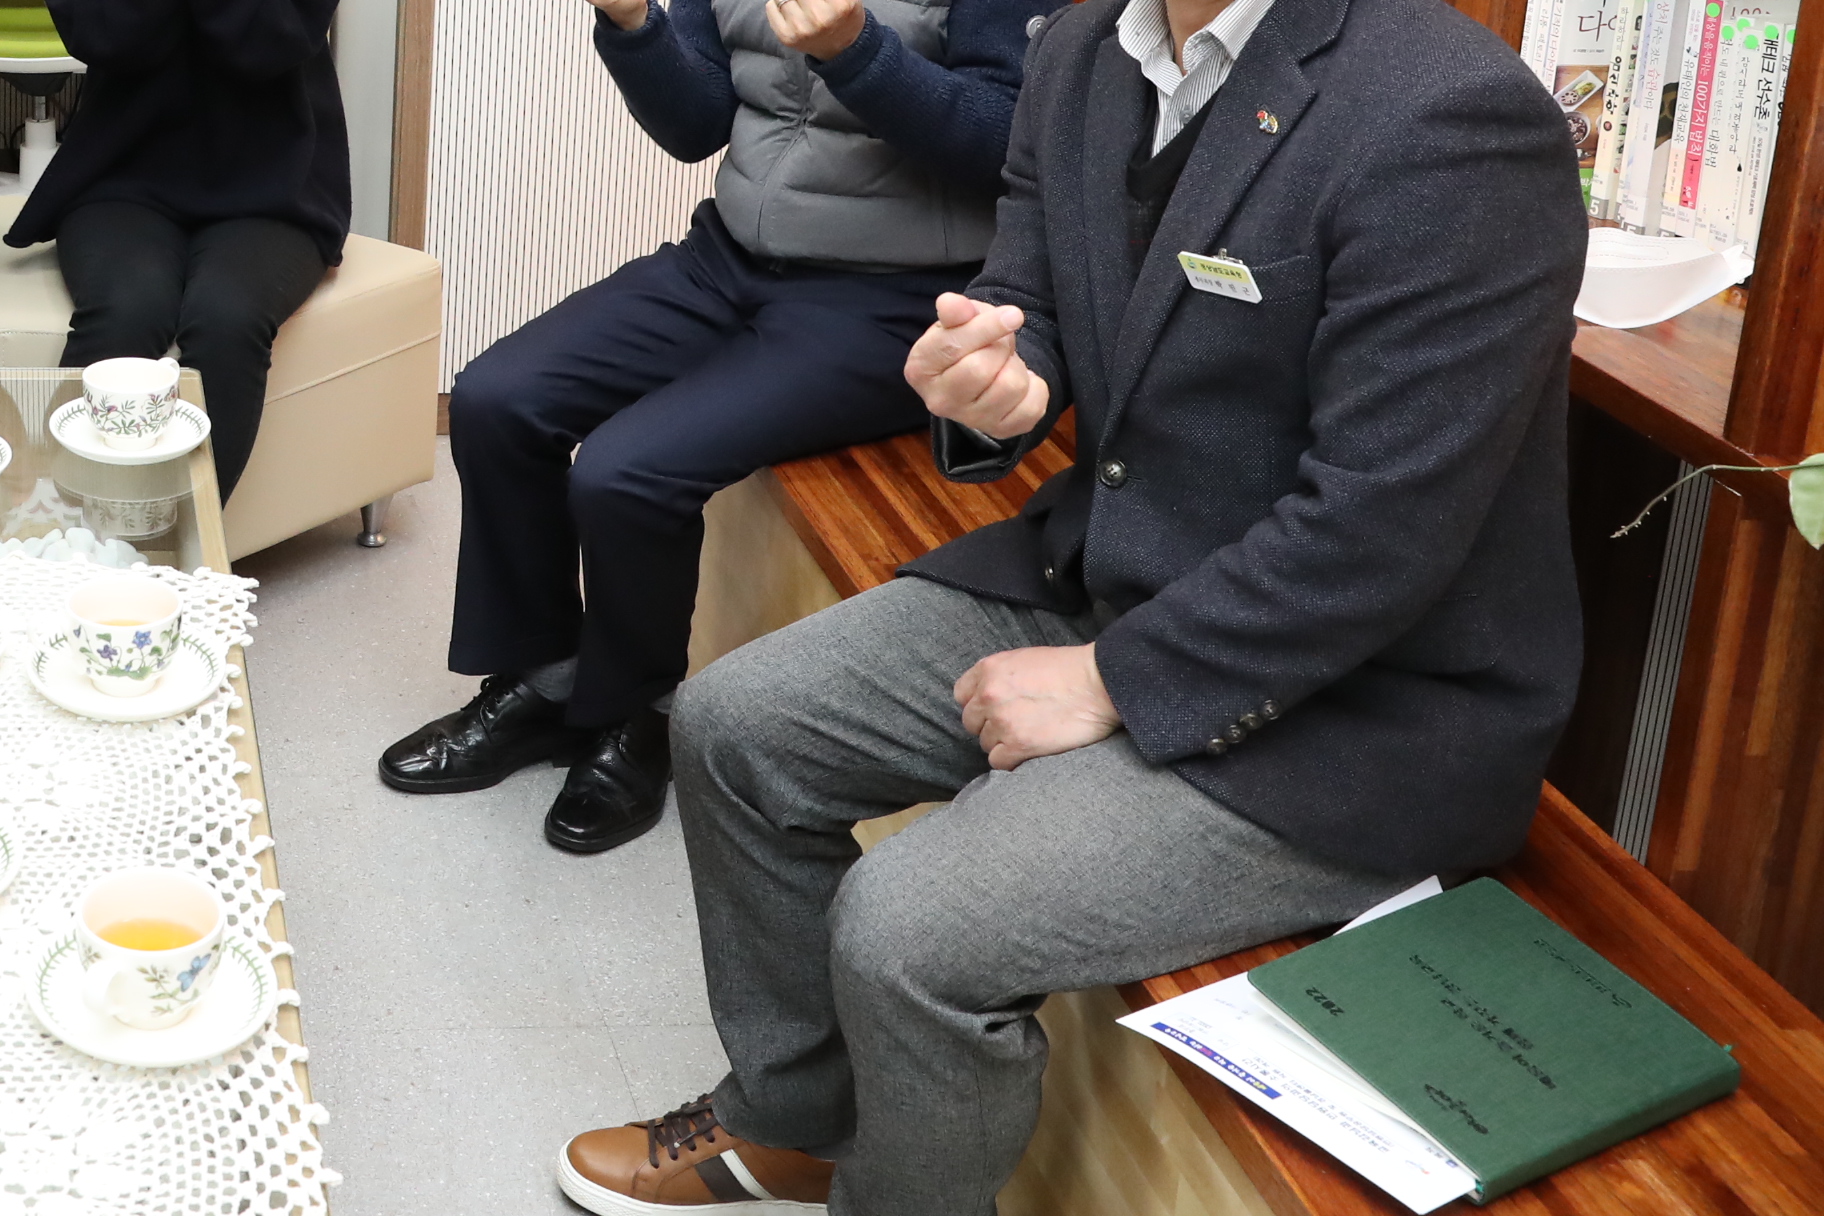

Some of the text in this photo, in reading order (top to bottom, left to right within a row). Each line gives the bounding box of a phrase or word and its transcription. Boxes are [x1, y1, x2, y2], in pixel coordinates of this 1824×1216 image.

[1678, 58, 1694, 100] 유태인의
[1719, 57, 1728, 67] 내
[1642, 67, 1660, 110] 습관이다
[1690, 79, 1710, 127] 100가지
[1754, 77, 1773, 120] 선수촌
[1672, 102, 1689, 144] 천재교육
[1711, 98, 1723, 126] 만드는
[1686, 129, 1704, 156] 법칙
[1703, 128, 1721, 168] 대화법
[1590, 198, 1600, 215] 5
[1302, 985, 1345, 1017] 2022
